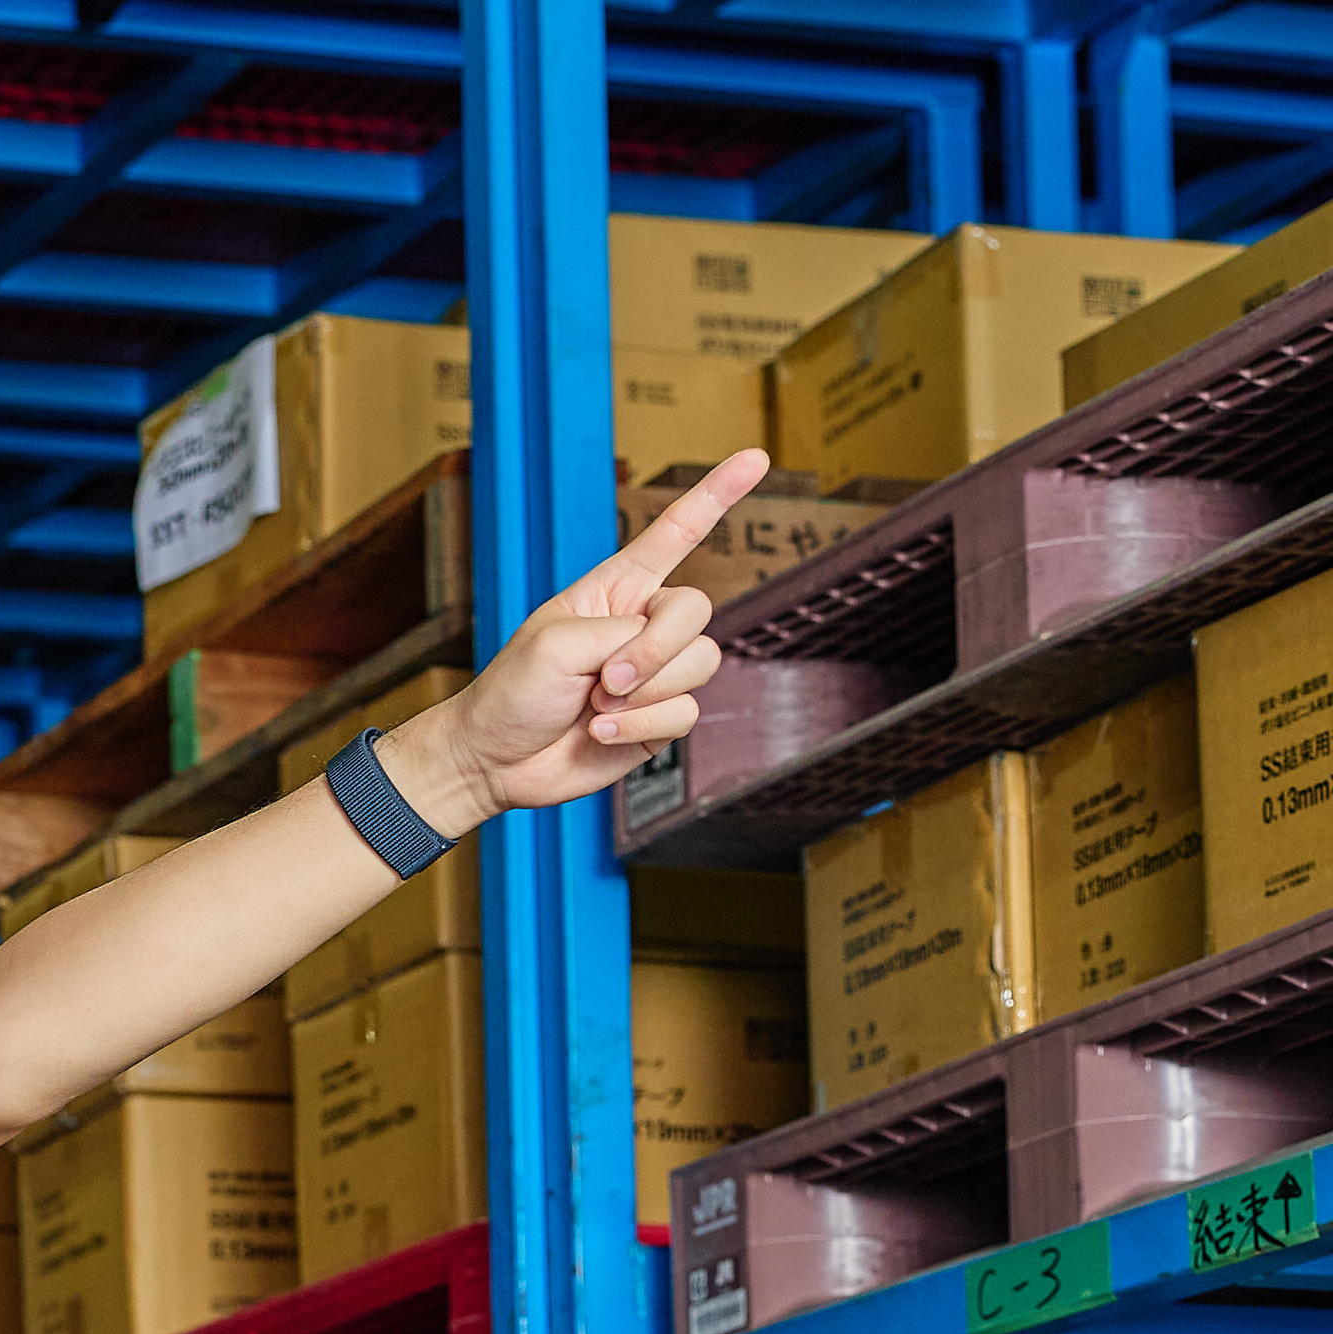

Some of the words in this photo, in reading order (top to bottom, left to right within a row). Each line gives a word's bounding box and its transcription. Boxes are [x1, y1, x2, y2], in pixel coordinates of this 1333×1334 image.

[1260, 731, 1333, 782] SS結束用
[977, 1246, 1062, 1321] C-3
